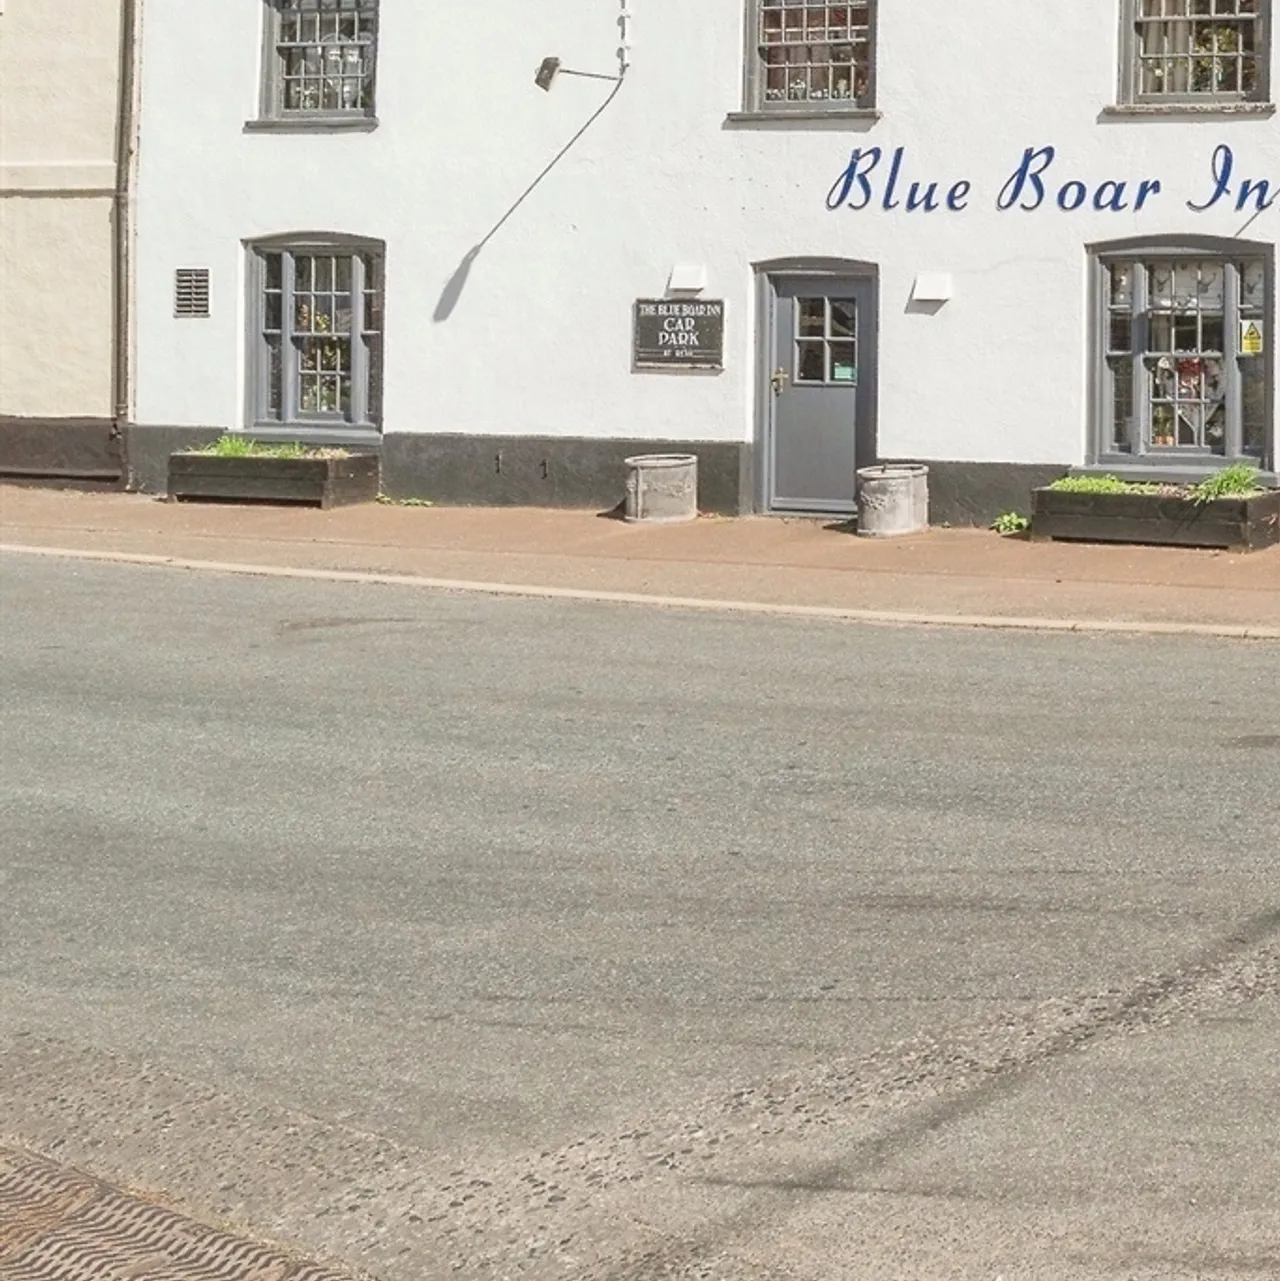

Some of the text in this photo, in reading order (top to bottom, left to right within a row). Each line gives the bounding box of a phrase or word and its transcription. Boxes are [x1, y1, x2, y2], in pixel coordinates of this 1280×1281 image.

[825, 146, 972, 211] Blue
[997, 145, 1161, 211] Boar
[658, 304, 680, 315] BLUE
[682, 304, 706, 316] BOAR
[707, 304, 721, 316] INN
[663, 317, 695, 331] CAR
[658, 332, 699, 345] PARK
